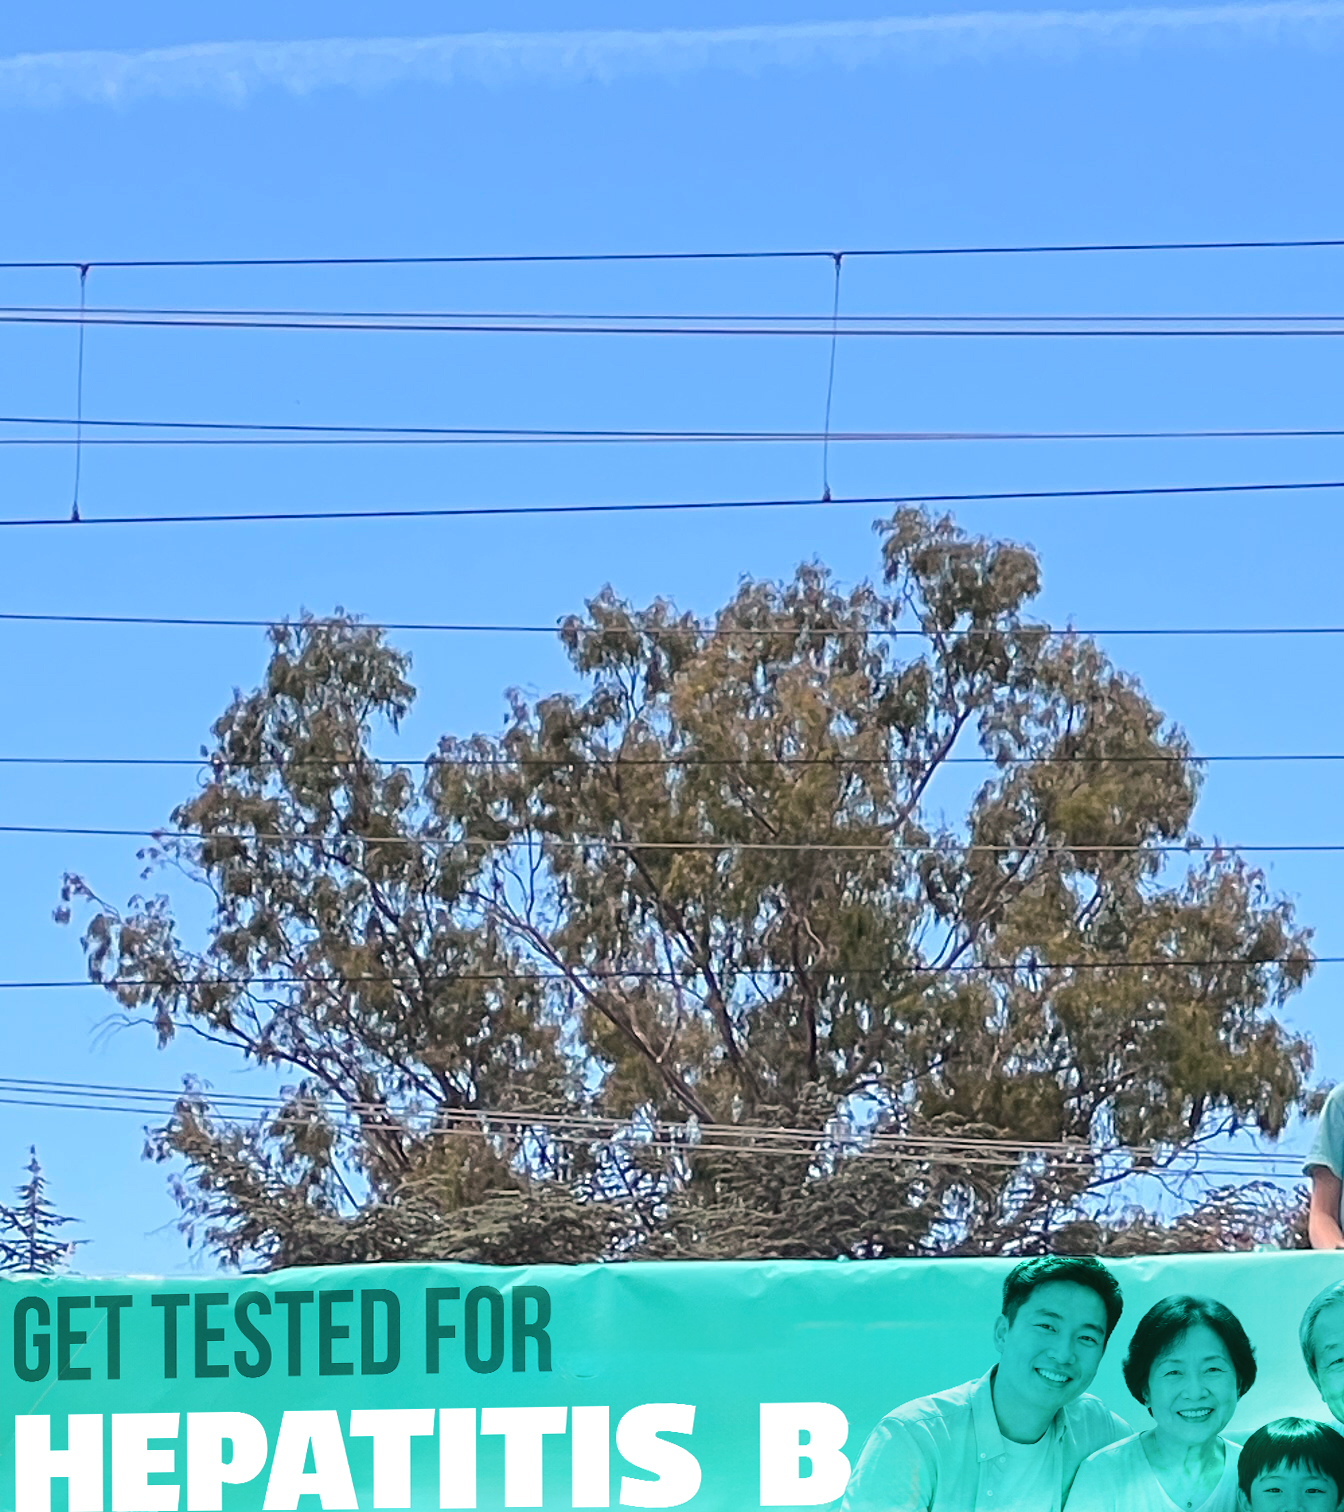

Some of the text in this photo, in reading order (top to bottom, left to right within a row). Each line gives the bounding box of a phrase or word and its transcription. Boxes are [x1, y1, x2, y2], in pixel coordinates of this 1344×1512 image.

[13, 1285, 553, 1383] GET TESTED FOR
[15, 1401, 852, 1512] HEPATITIS B
